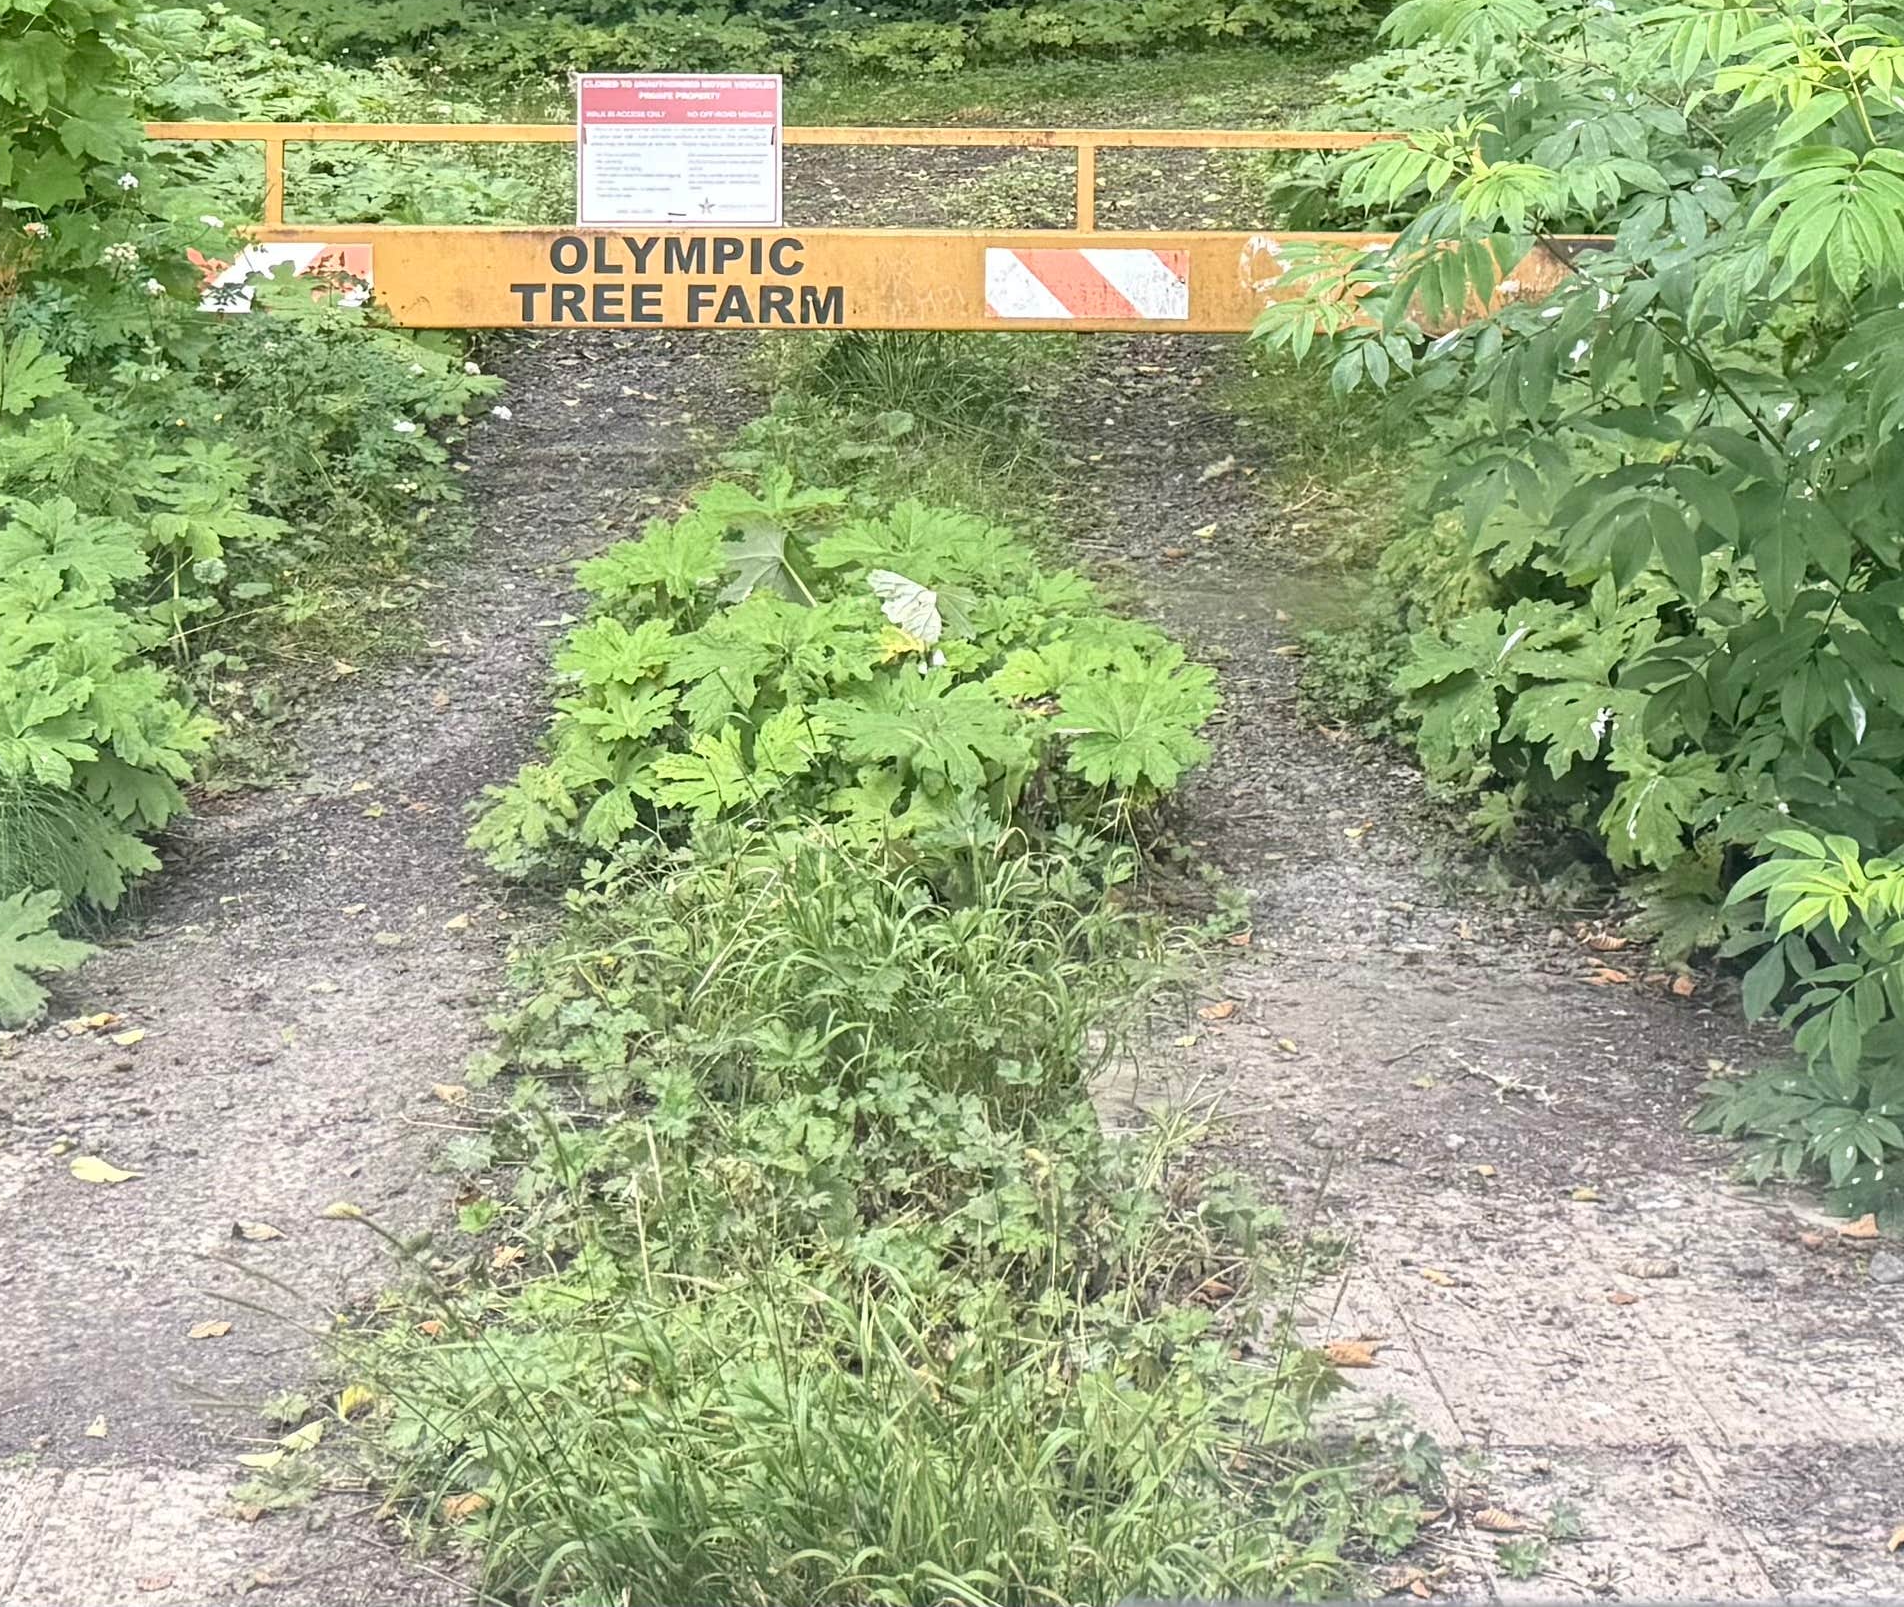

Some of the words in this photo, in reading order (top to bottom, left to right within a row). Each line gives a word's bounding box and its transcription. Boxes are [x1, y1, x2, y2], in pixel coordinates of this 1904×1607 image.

[675, 91, 721, 100] PROPERTY
[550, 236, 804, 275] OLYMPIC
[510, 283, 663, 322] TREE
[687, 284, 843, 324] FARM
